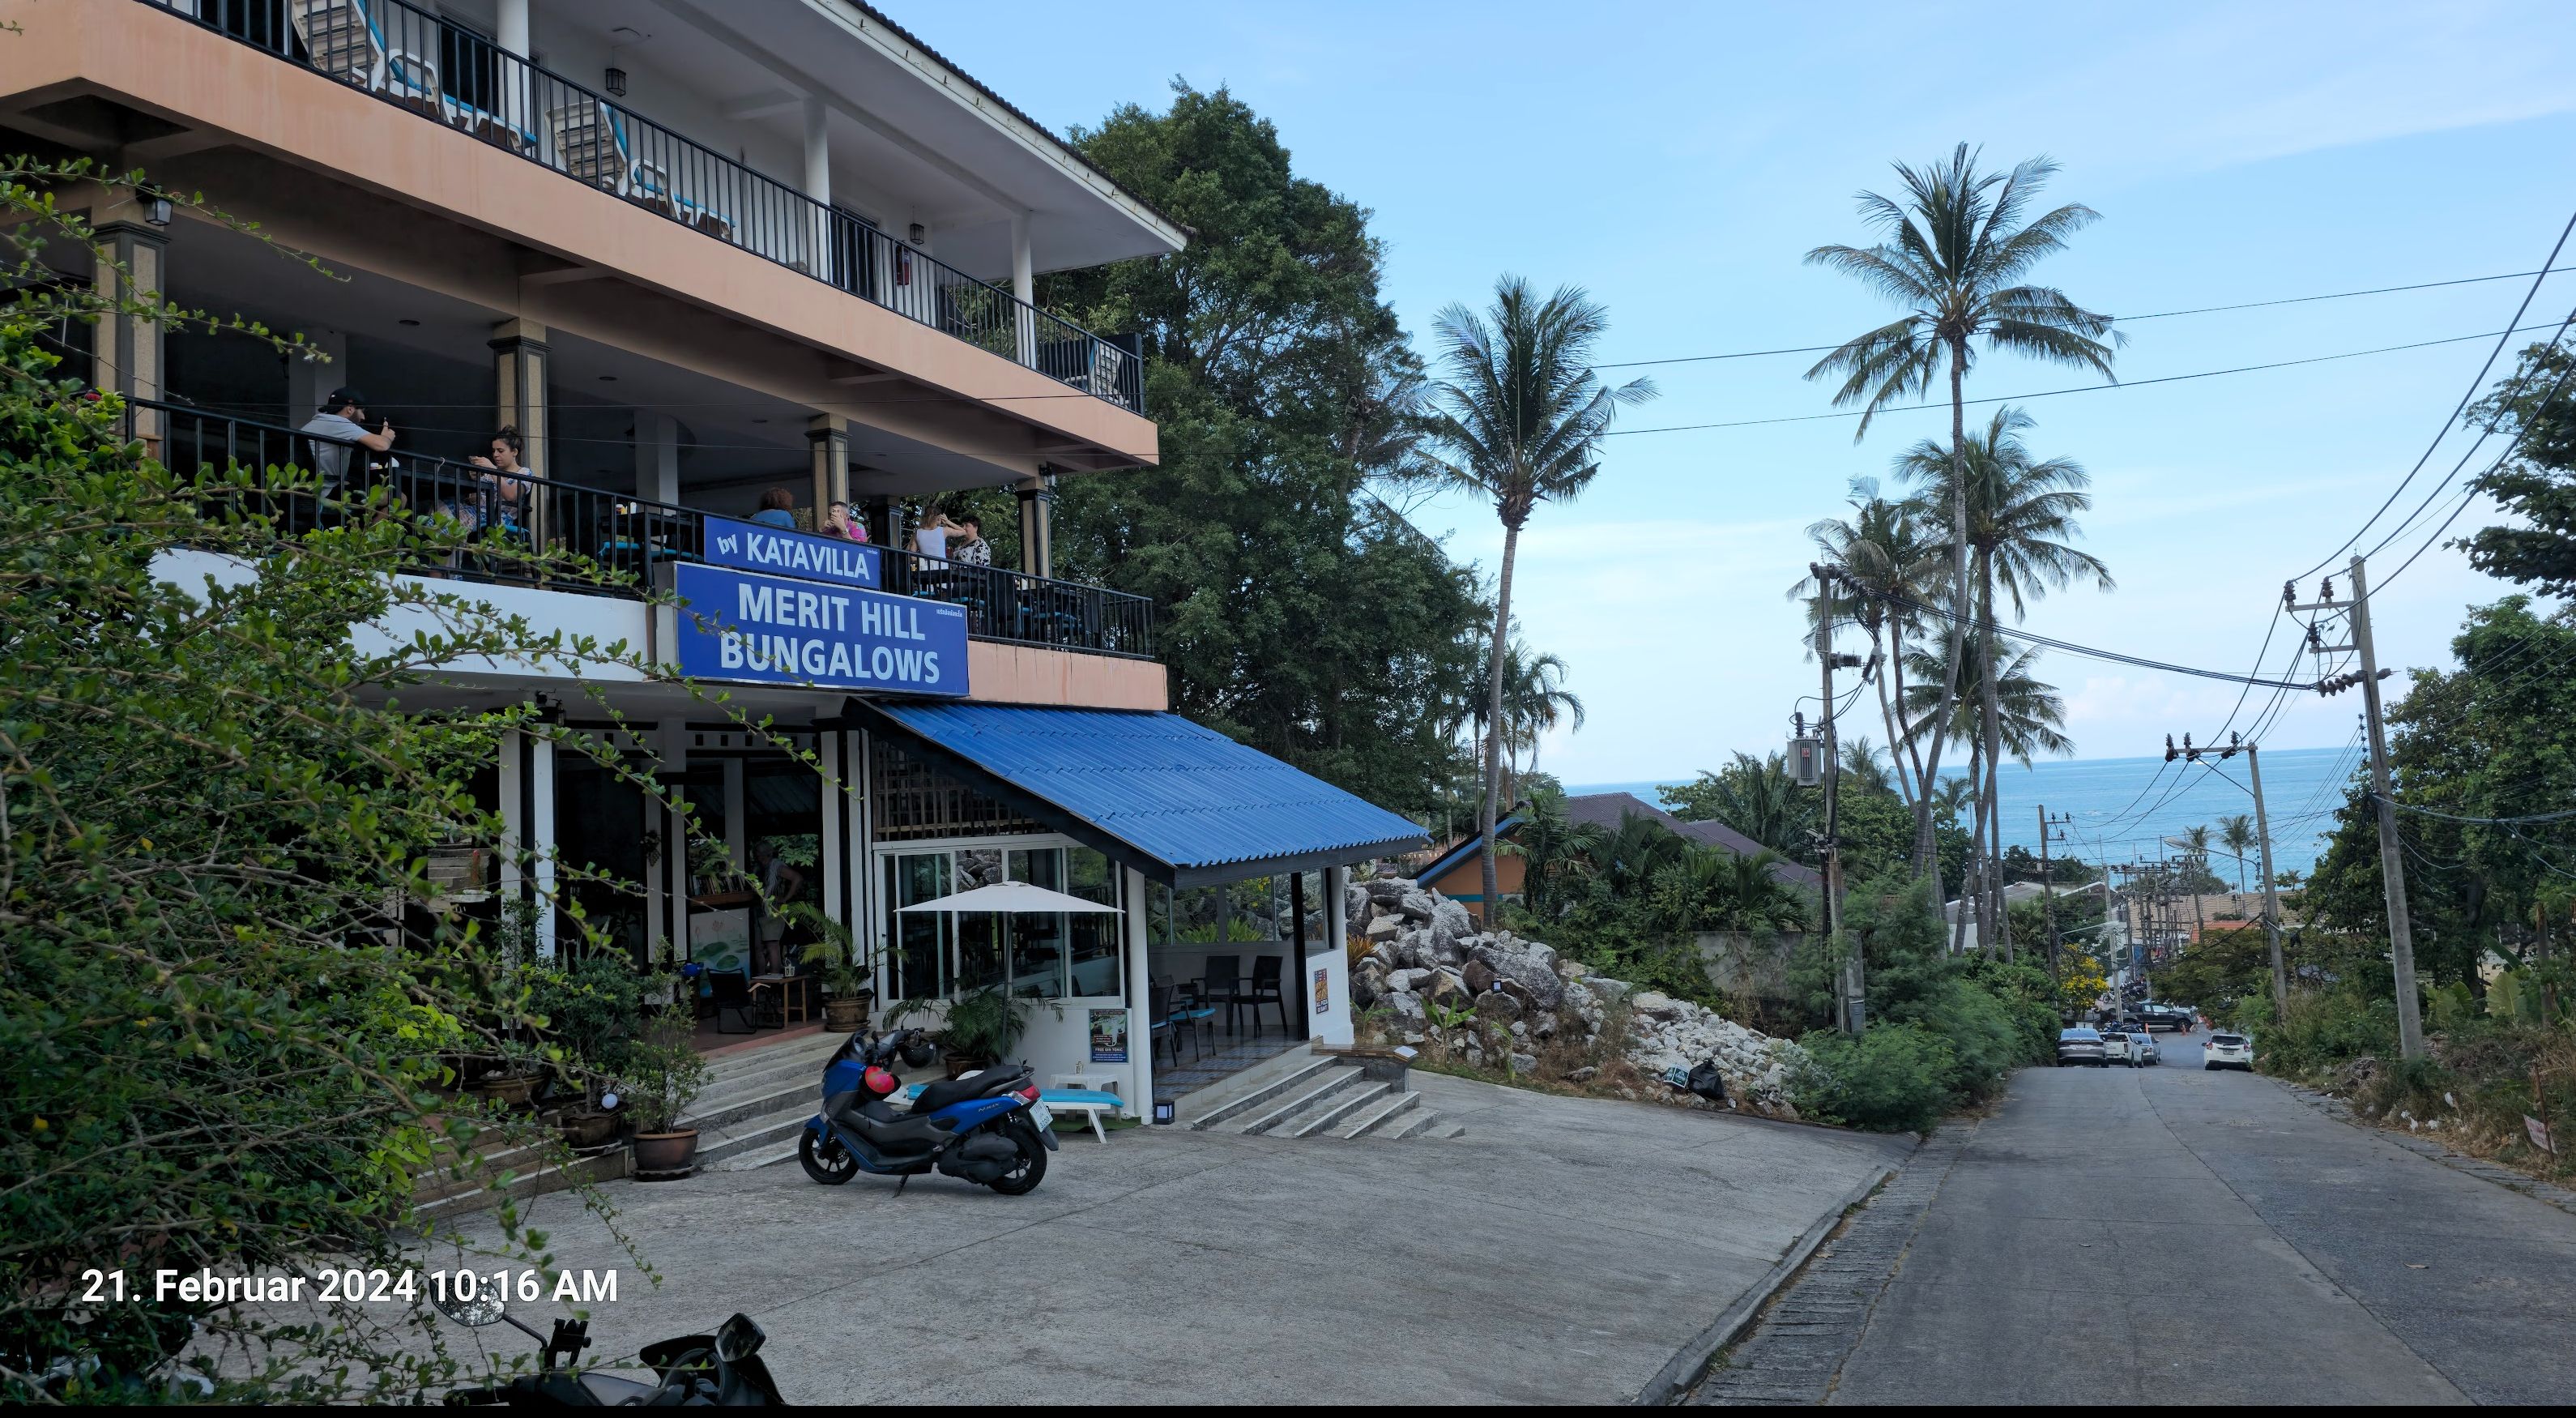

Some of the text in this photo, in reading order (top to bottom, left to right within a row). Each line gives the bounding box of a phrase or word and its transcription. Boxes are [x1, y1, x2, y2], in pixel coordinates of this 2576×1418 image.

[717, 532, 870, 580] by KATAVILLA
[738, 583, 926, 641] MERIT HILL
[720, 630, 940, 684] BUNGALOWS
